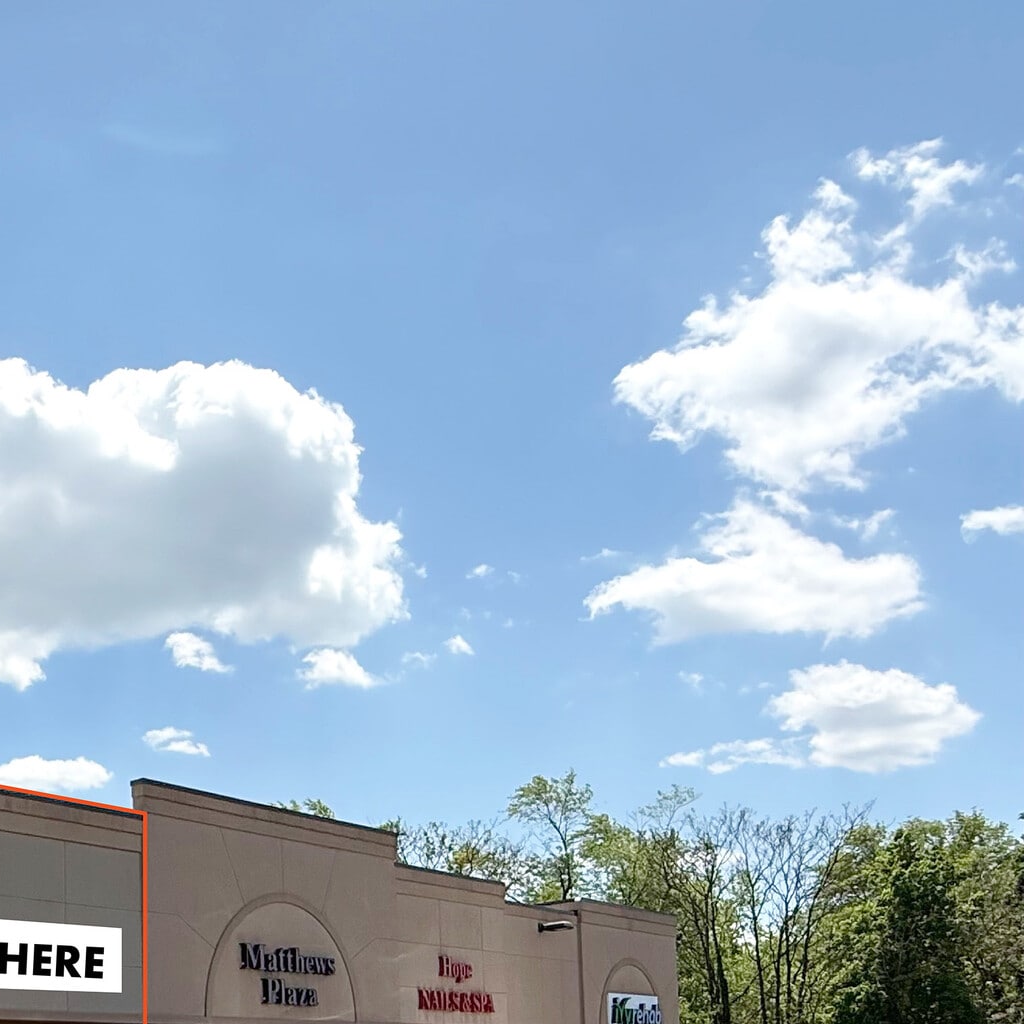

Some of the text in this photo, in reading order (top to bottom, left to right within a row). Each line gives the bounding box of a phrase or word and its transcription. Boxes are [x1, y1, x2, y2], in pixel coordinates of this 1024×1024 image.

[239, 943, 336, 975] Matthews
[438, 954, 473, 983] Hope
[260, 978, 319, 1007] Plaza
